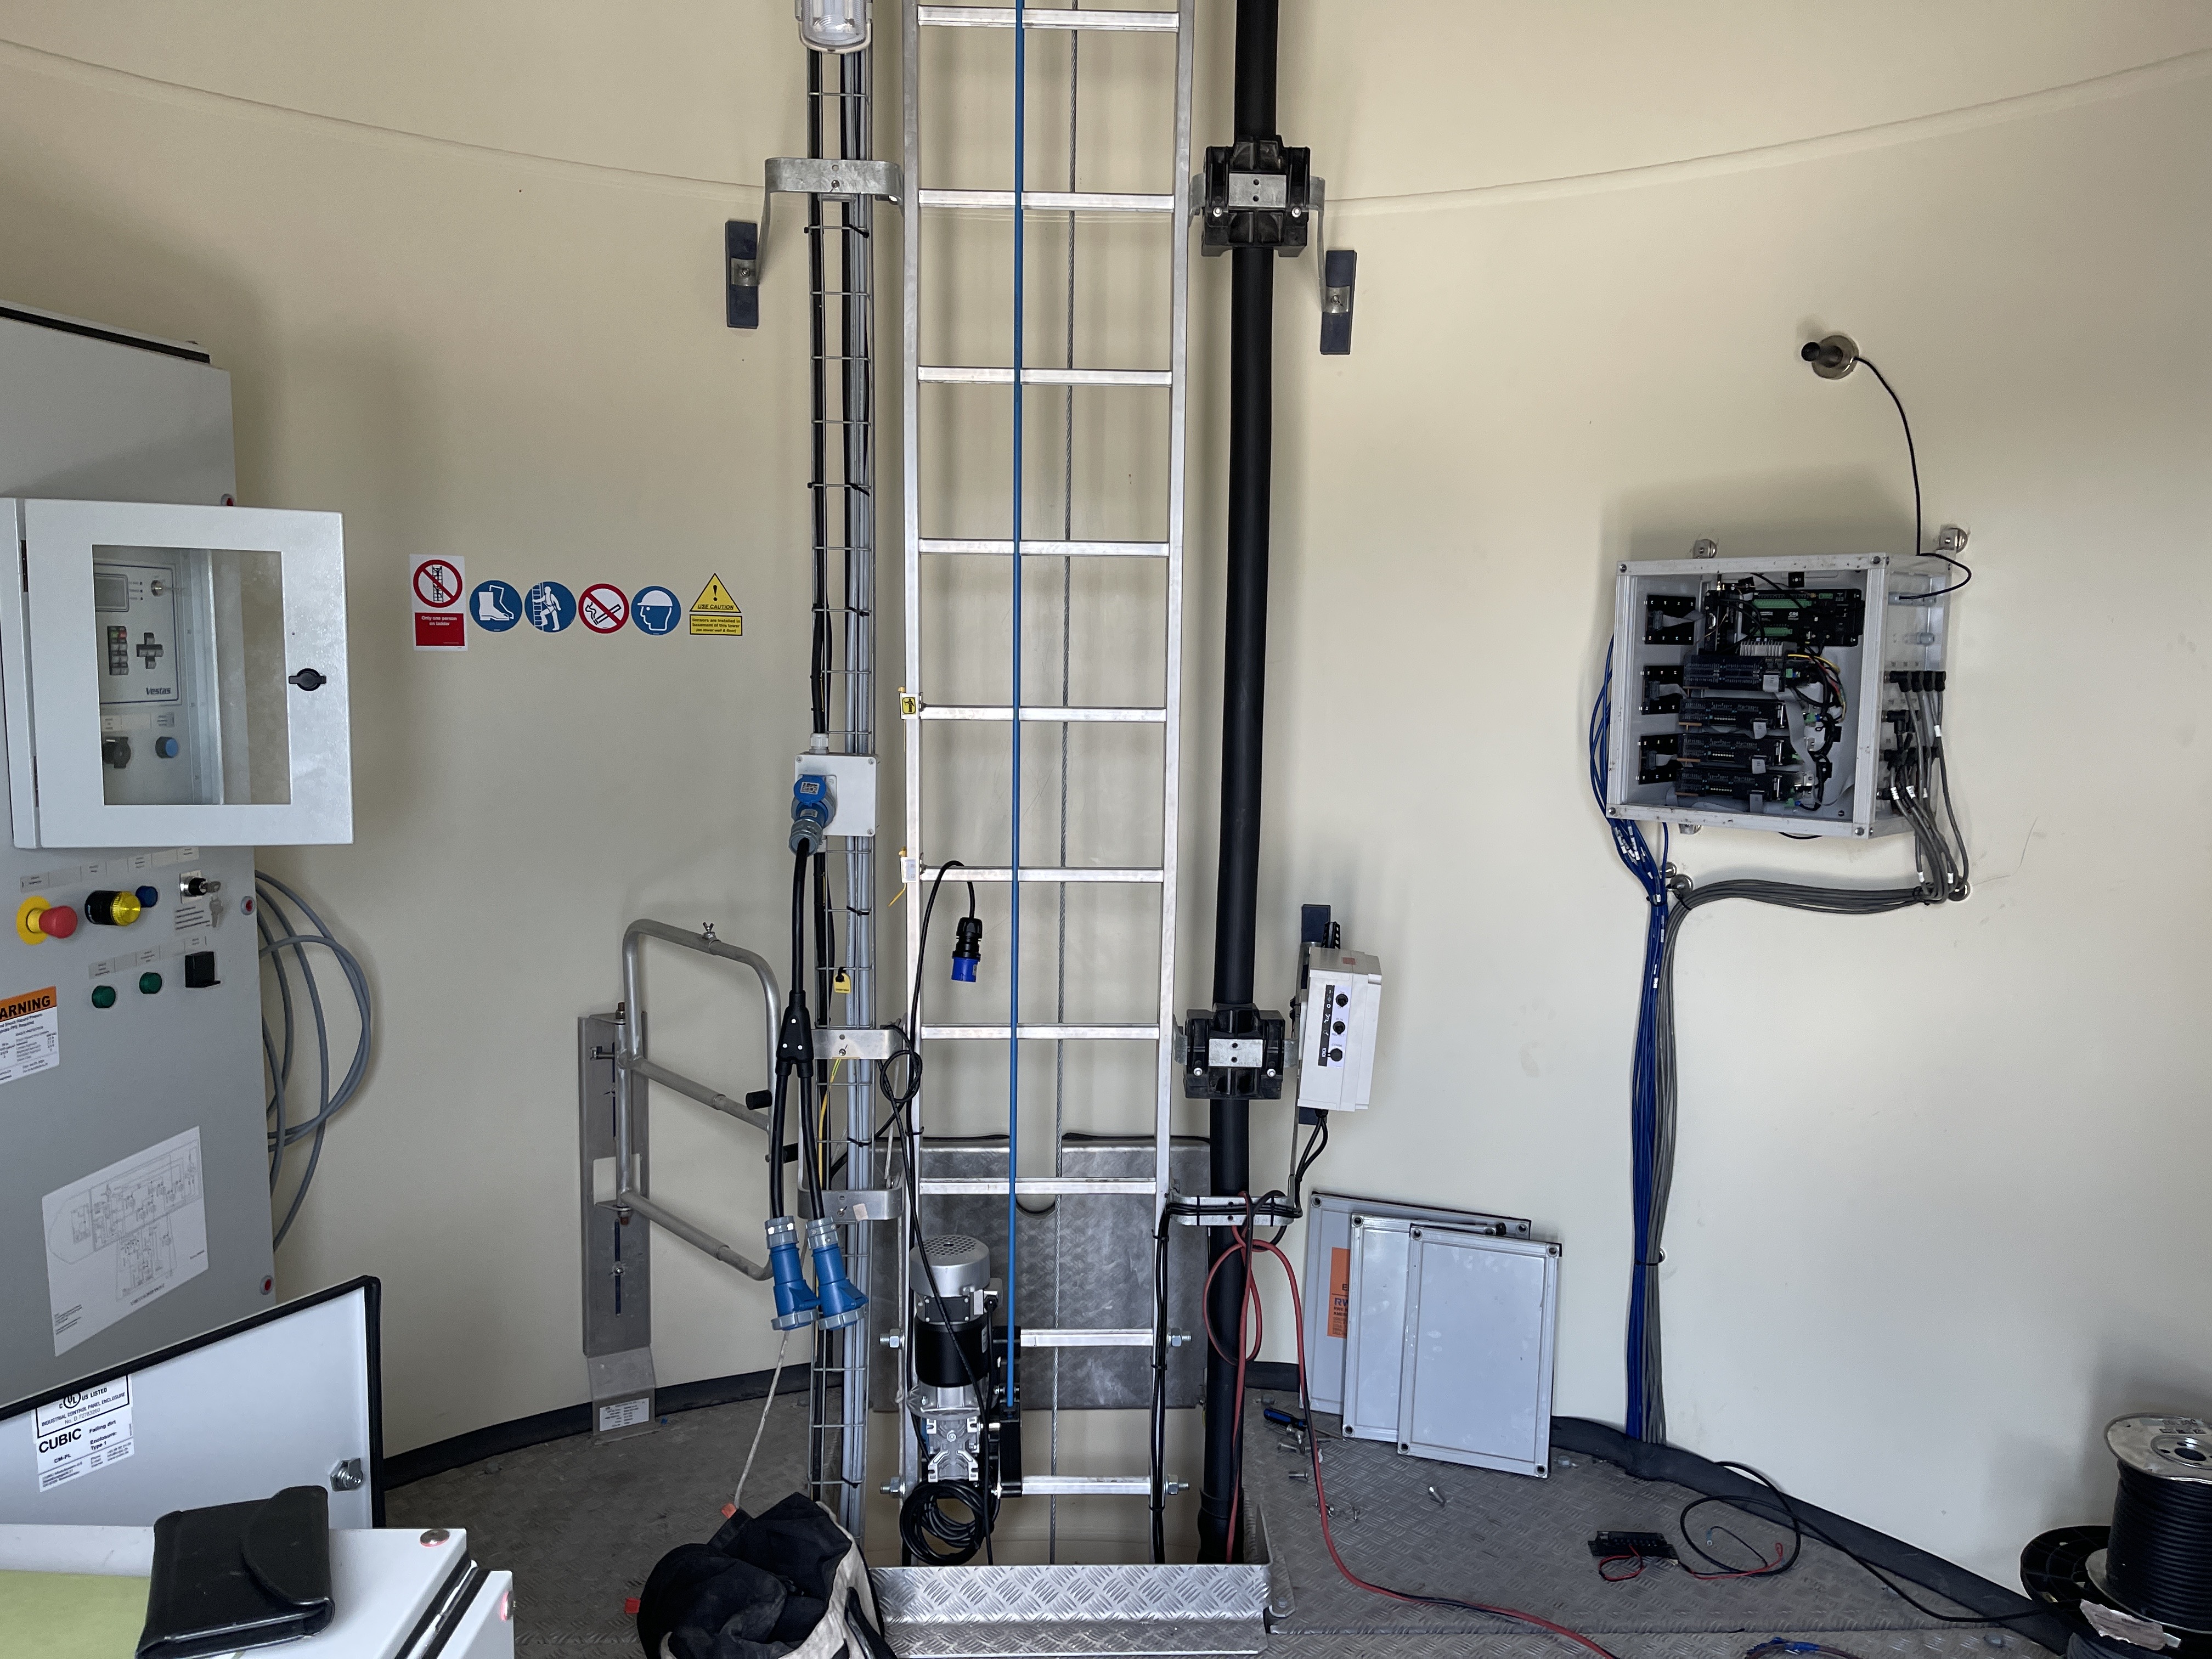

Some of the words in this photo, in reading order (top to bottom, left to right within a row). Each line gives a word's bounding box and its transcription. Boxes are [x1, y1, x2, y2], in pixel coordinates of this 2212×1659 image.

[146, 687, 171, 695] Vestas
[0, 995, 50, 1019] ARNING
[1335, 1297, 1348, 1306] RW
[67, 1395, 77, 1404] UL
[91, 1387, 108, 1397] LISTED
[41, 1414, 66, 1426] INDUSTRIAL
[67, 1407, 87, 1417] CONTROL
[101, 1392, 125, 1404] ENCLOSURE
[89, 1424, 106, 1434] Falling
[39, 1428, 82, 1453] CUBIC
[90, 1432, 117, 1444] Enclosure:
[54, 1454, 71, 1463] CM-PL
